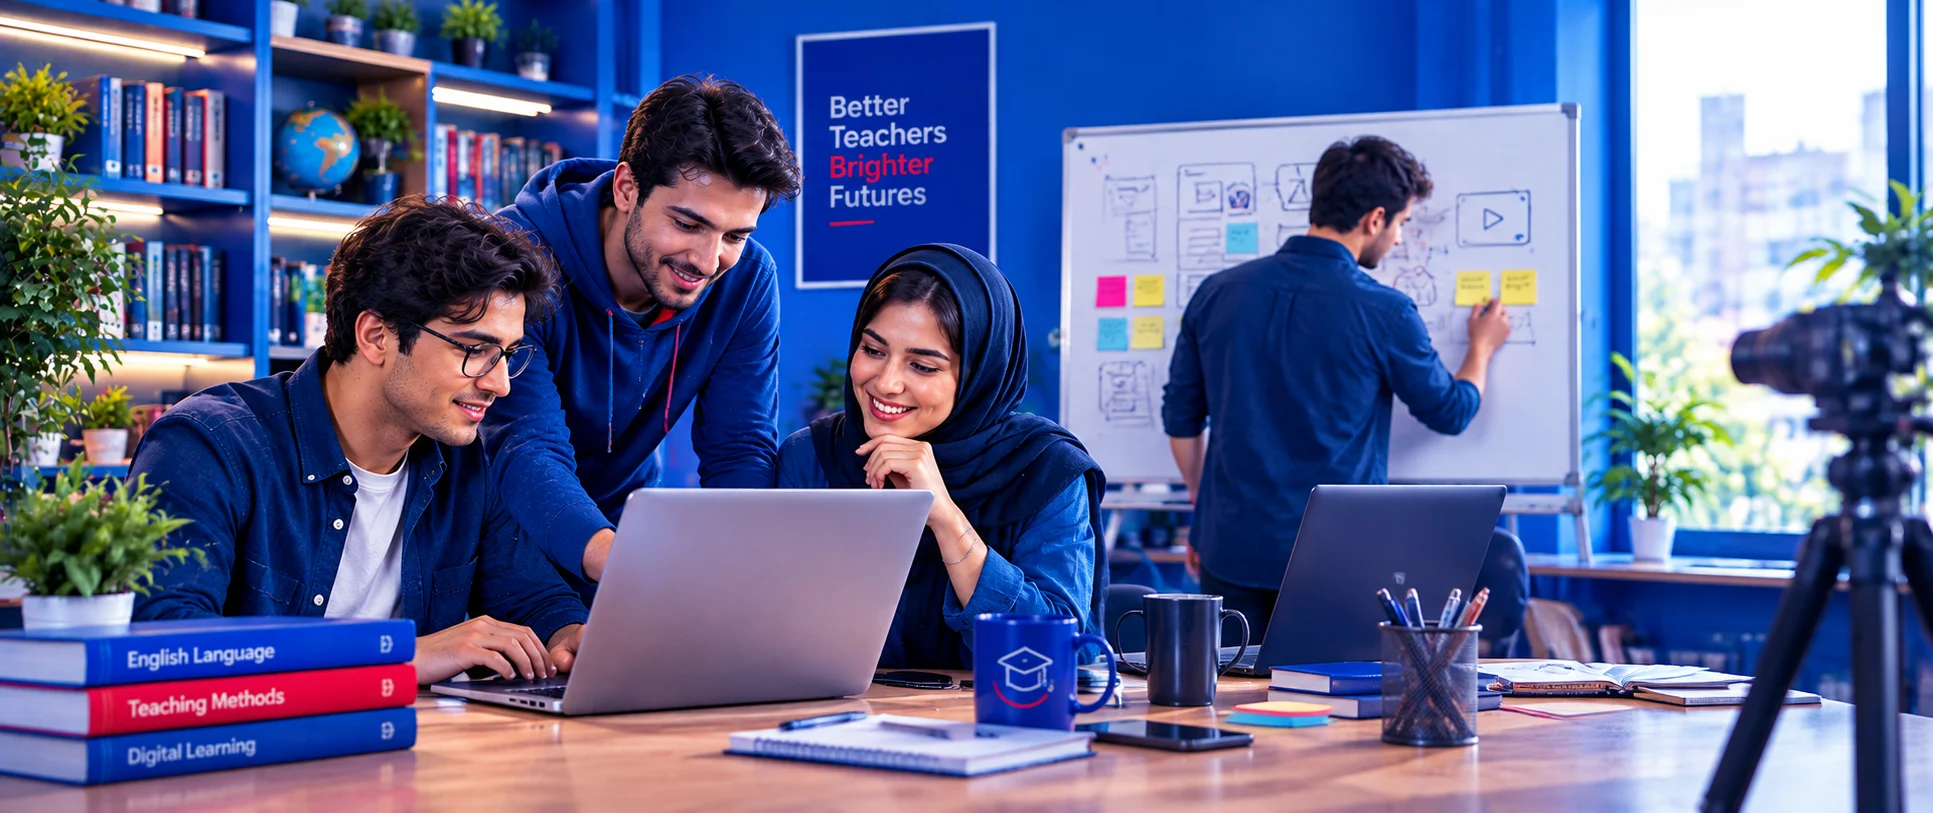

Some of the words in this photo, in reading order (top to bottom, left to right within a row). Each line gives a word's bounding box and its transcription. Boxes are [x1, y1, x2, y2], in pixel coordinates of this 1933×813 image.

[830, 95, 910, 119] Better
[829, 122, 947, 149] Teachers
[830, 153, 934, 183] Brighter
[830, 185, 927, 208] Futures
[127, 647, 189, 671] English
[193, 646, 275, 666] Language
[128, 695, 207, 718] Teaching
[211, 688, 285, 710] Methods
[128, 743, 182, 767] Digital
[186, 738, 256, 759] Learning
